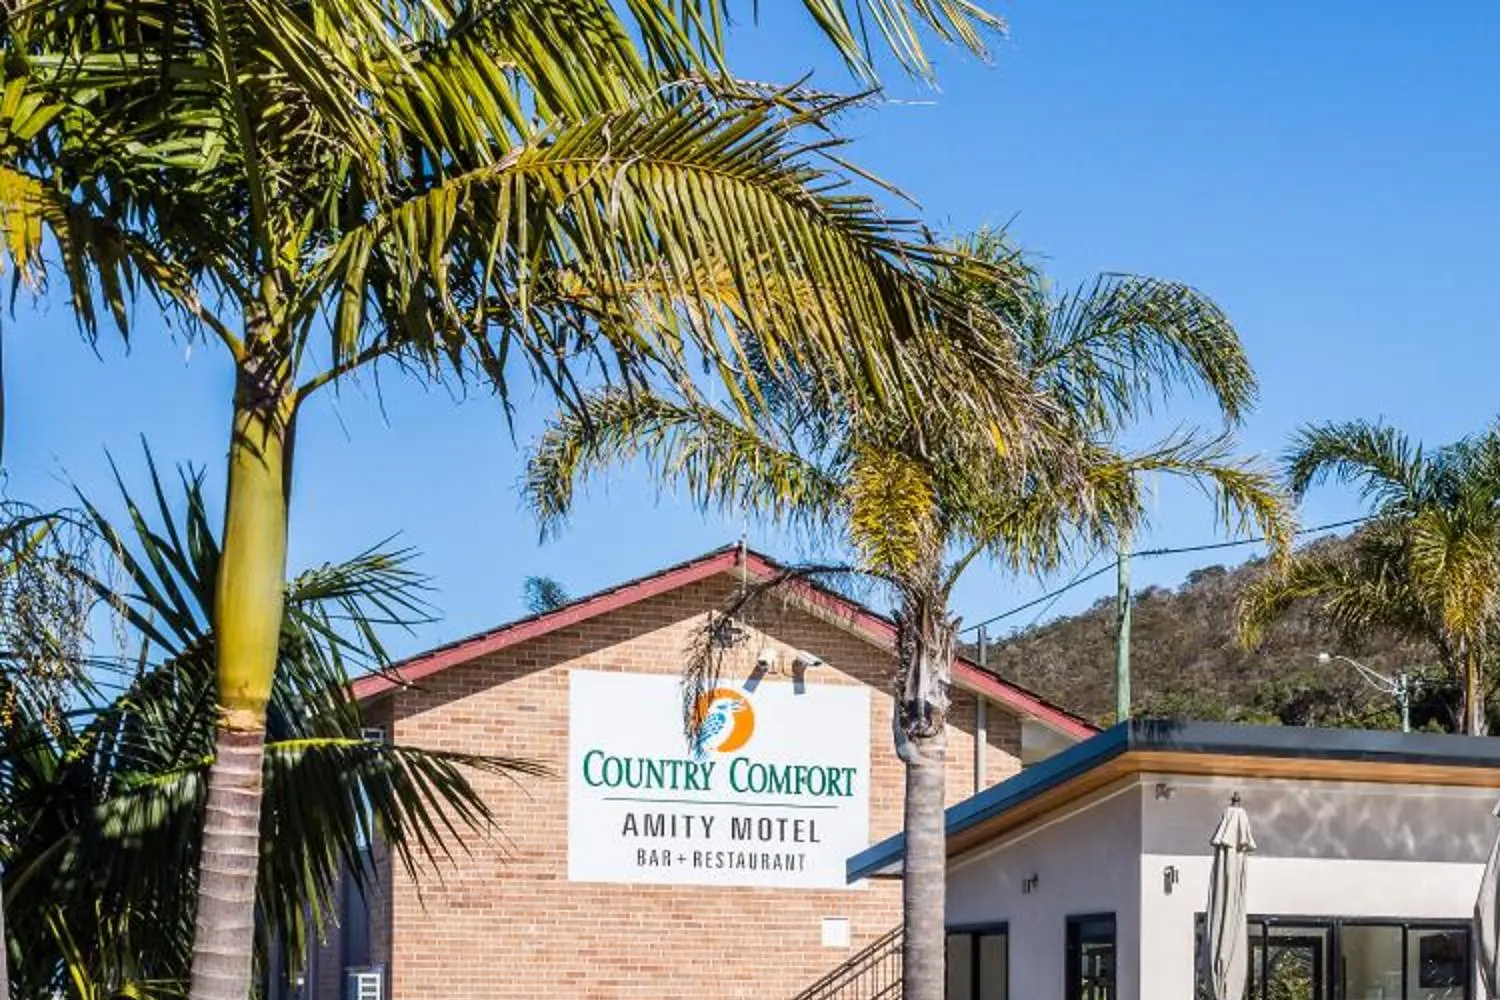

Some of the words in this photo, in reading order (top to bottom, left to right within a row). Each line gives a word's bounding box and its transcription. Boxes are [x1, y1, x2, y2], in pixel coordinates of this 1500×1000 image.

[583, 750, 717, 791] COUNTRY
[729, 757, 857, 797] COMFORT
[622, 813, 715, 840] AMITY
[731, 816, 821, 844] MOTEL
